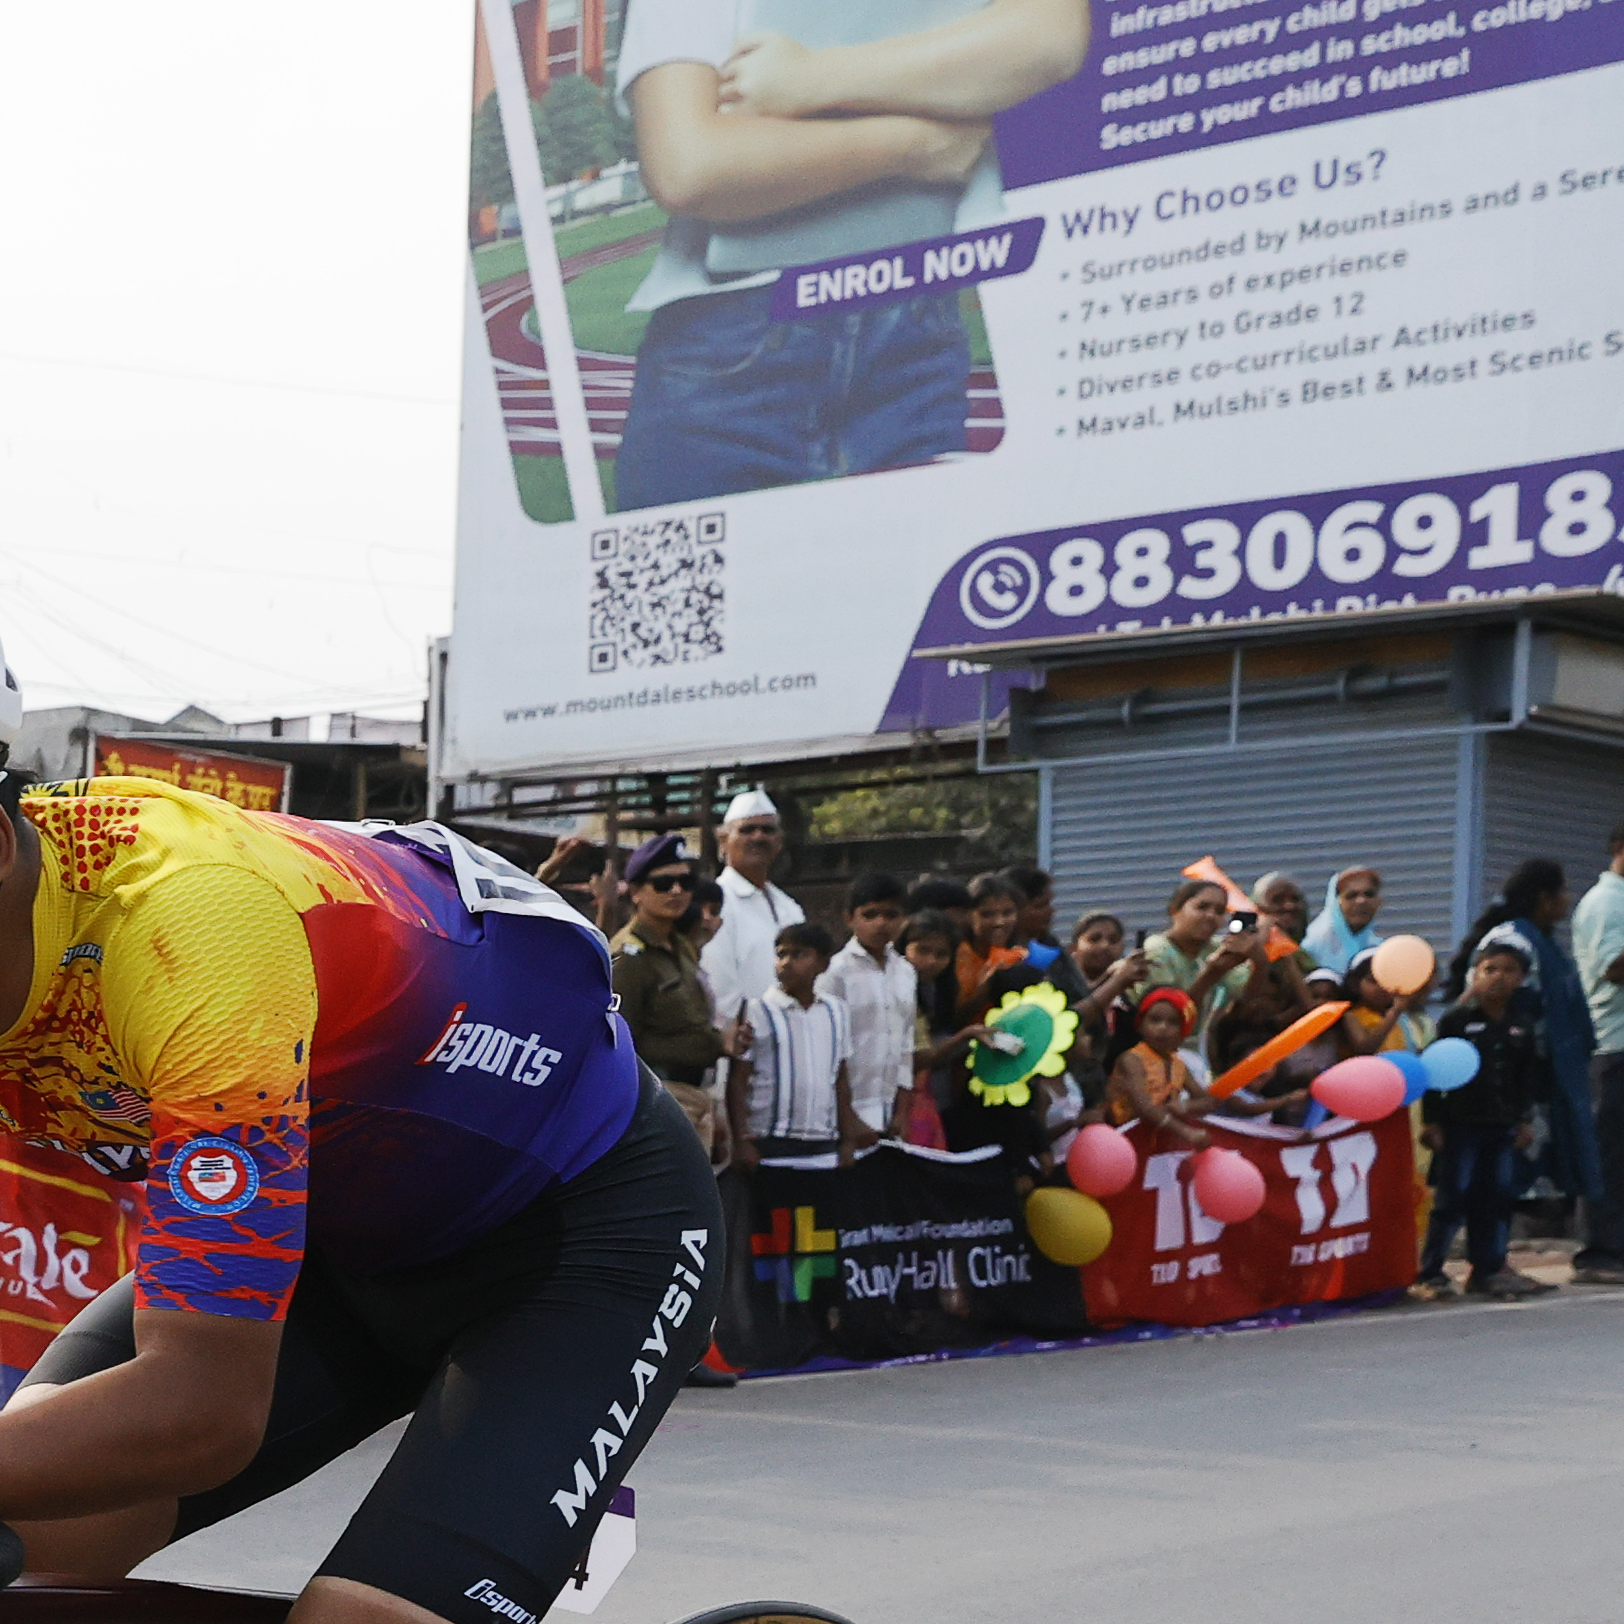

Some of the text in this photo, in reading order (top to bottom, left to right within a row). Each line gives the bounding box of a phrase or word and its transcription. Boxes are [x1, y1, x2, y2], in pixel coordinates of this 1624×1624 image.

[1100, 74, 1168, 112] need
[1172, 70, 1199, 97] to
[1206, 46, 1320, 90] succeed
[1326, 37, 1354, 65] in
[1101, 35, 1196, 77] ensure
[1200, 15, 1281, 55] every
[1285, 0, 1355, 34] child
[1100, 48, 1471, 150] Secure your child's future!
[1061, 149, 1388, 241] Why Choose Us?
[1080, 164, 1624, 284] Surrounded by Mountains and a Sere
[796, 235, 1012, 308] ENROL NOW
[1080, 248, 1409, 322] 7+ Years of experience
[1077, 307, 1537, 401] Diverse co-curricular Activities
[1078, 291, 1367, 361] Nursery to Grade 12
[1172, 384, 1291, 424] Mulshi's
[1300, 374, 1366, 405] Best
[1375, 369, 1394, 394] &
[1405, 356, 1478, 387] Most
[1487, 340, 1592, 378] Scenic
[1602, 329, 1624, 357] S
[1044, 469, 1624, 617] 88306918
[504, 673, 817, 723] www.mountdaleschool.com
[967, 1243, 1033, 1288] Clinic
[550, 1229, 708, 1528] MALAYSIA
